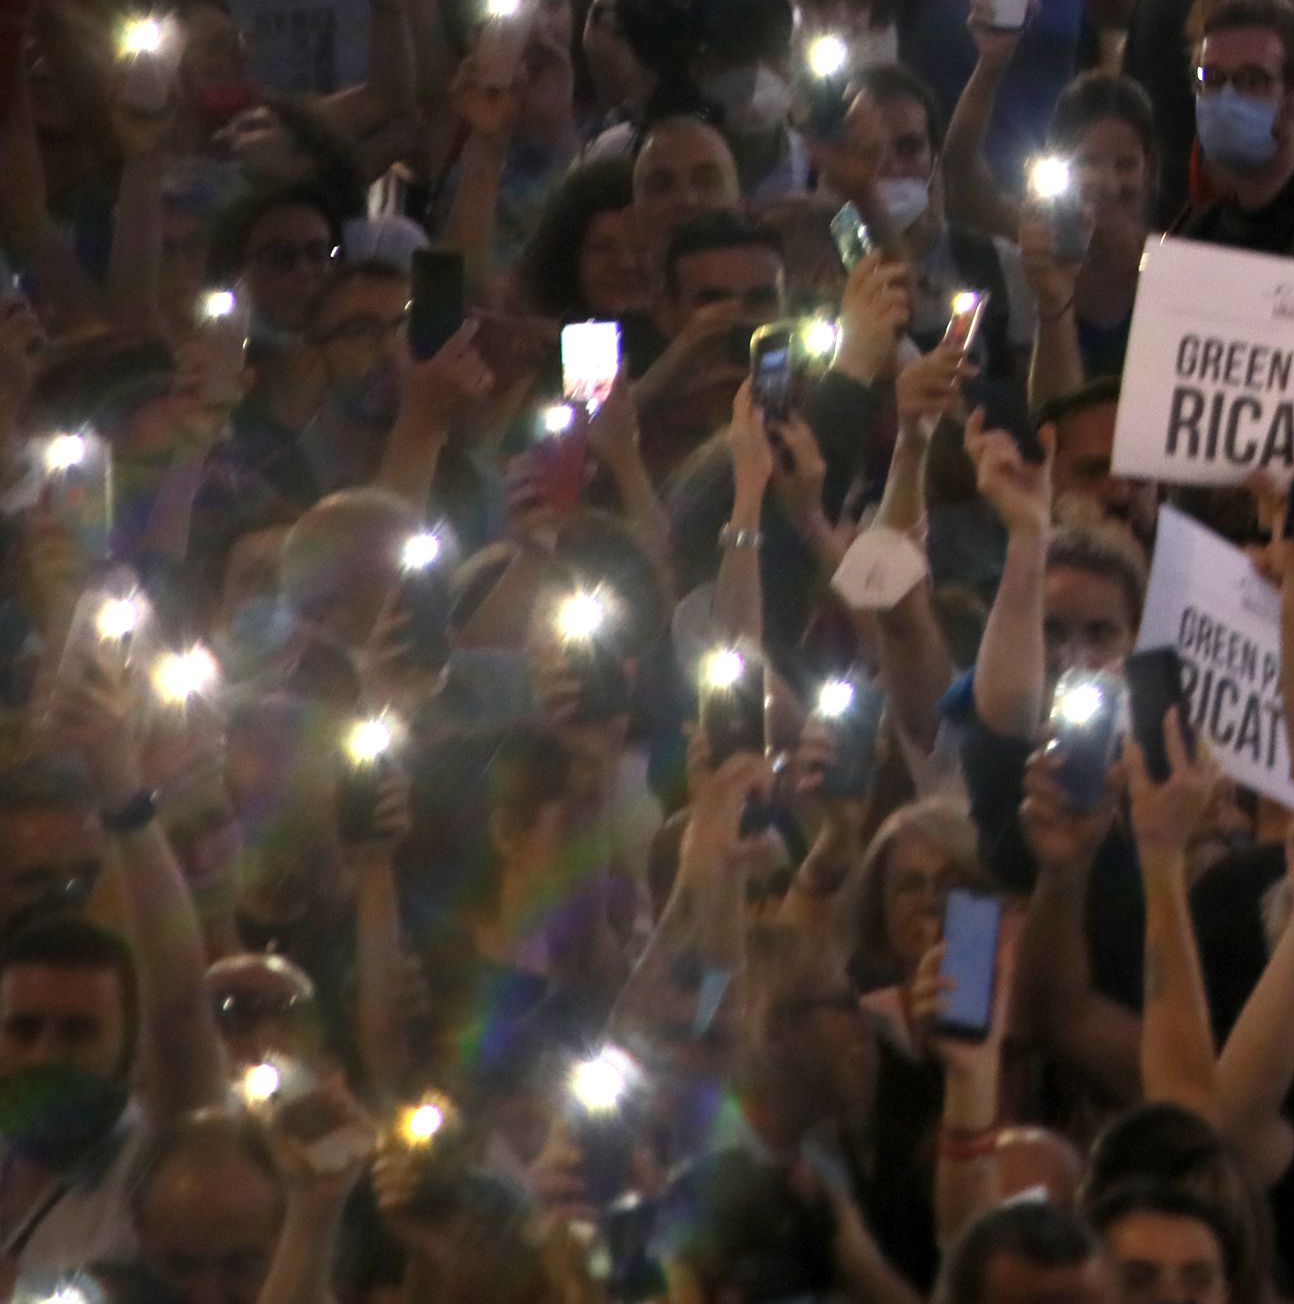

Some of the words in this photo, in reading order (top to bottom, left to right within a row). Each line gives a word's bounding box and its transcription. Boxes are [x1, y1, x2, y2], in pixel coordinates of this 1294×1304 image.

[1174, 333, 1294, 393] GREEN
[1177, 605, 1258, 689] GREEN
[1178, 656, 1283, 770] RICAT
